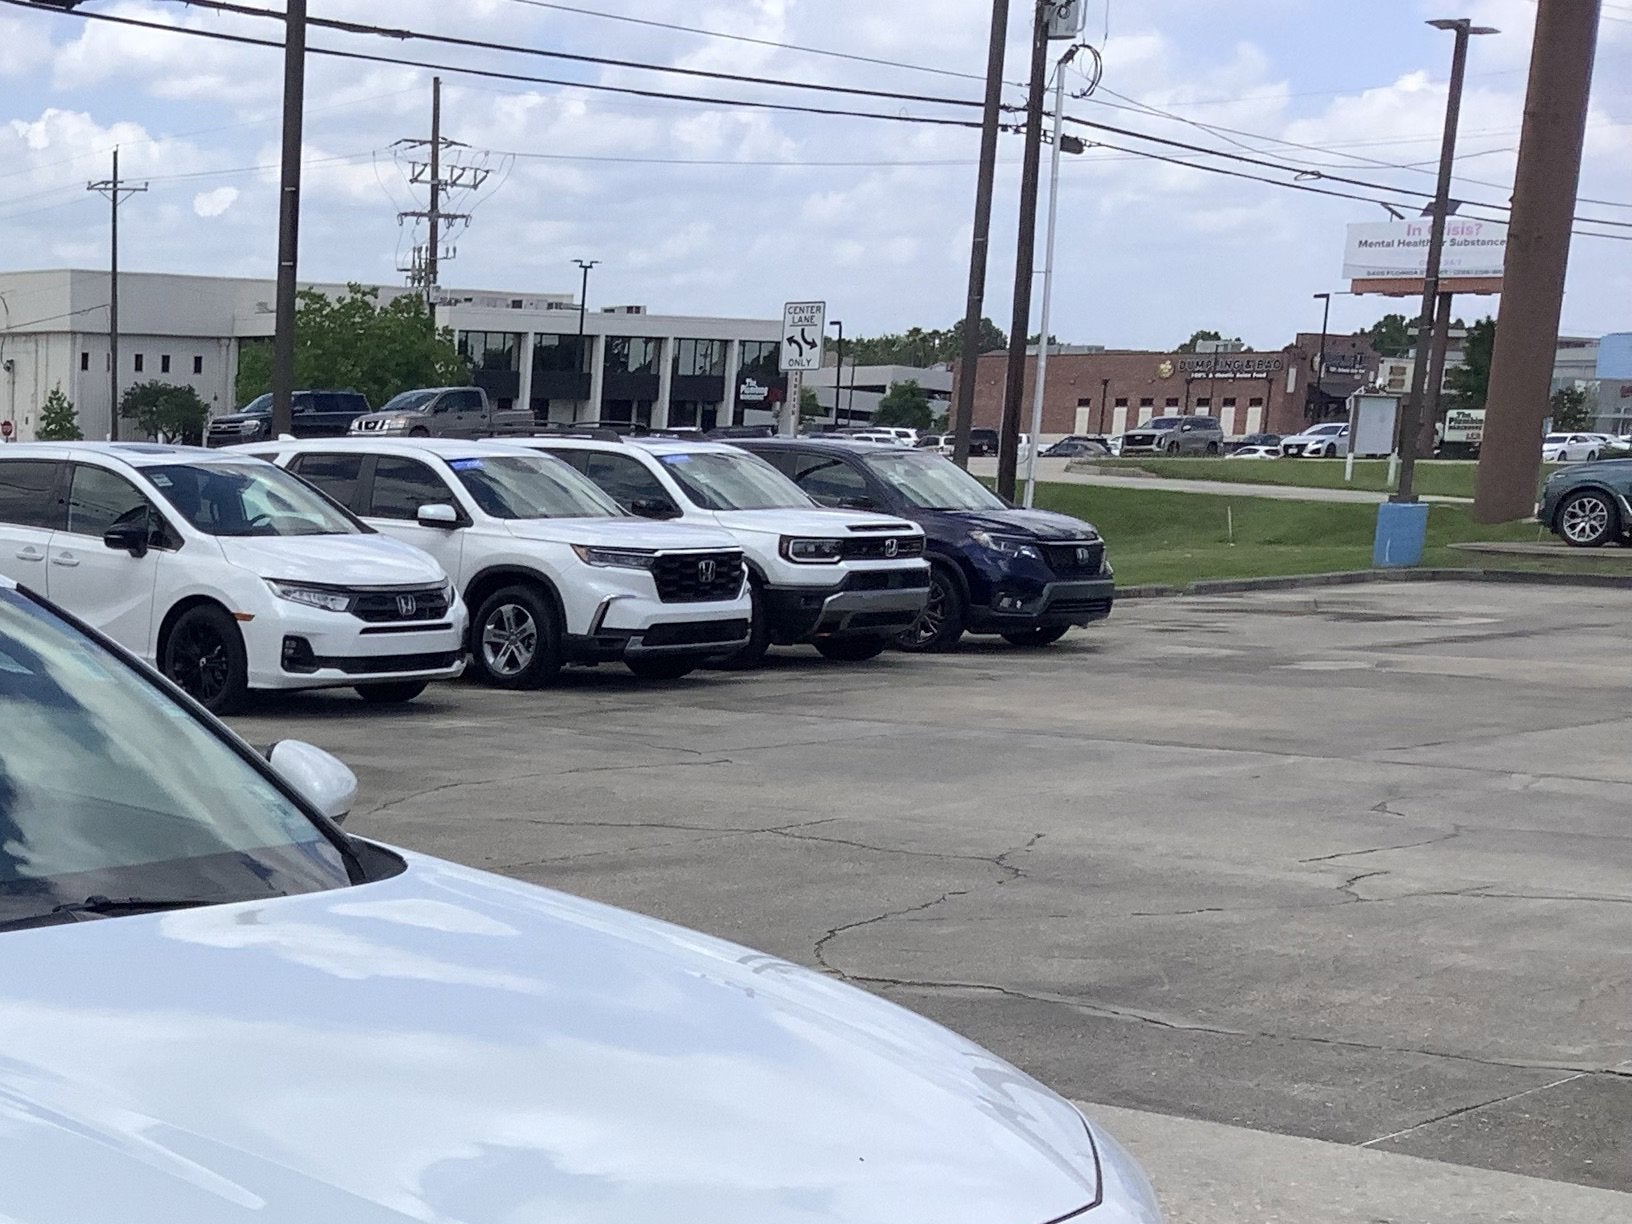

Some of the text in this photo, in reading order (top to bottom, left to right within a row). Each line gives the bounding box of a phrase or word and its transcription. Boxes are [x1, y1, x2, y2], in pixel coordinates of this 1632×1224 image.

[1406, 222, 1483, 237] In isis?
[1358, 238, 1395, 248] Mental
[1449, 237, 1506, 248] Substance
[788, 305, 822, 315] CENTER
[792, 315, 816, 324] LANE
[788, 358, 813, 367] ONLY
[1179, 360, 1240, 370] DUMPING
[1256, 360, 1282, 370] BAO
